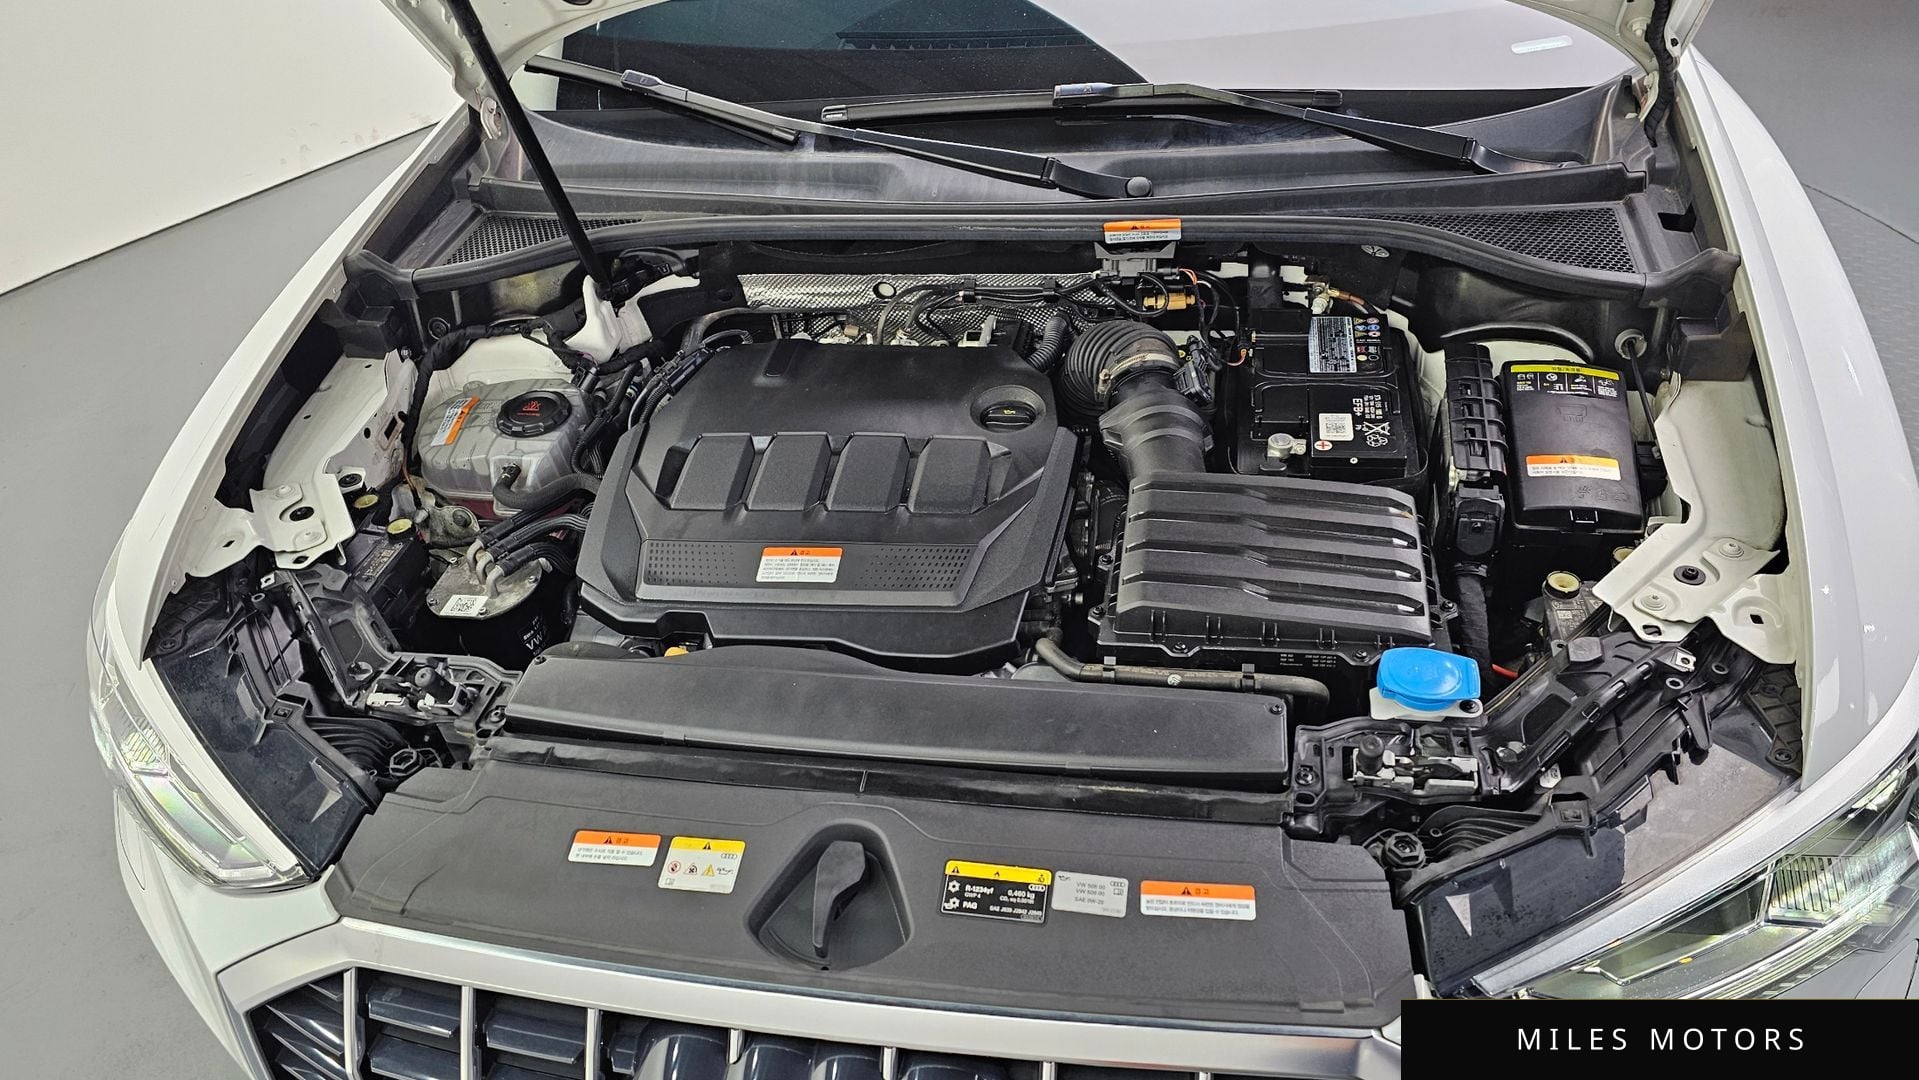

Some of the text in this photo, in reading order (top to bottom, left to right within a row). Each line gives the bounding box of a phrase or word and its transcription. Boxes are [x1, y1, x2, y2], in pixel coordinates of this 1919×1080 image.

[1352, 398, 1364, 417] EFB+
[965, 884, 994, 895] R-1234yf
[1026, 891, 1035, 900] kg
[962, 901, 978, 910] PAG
